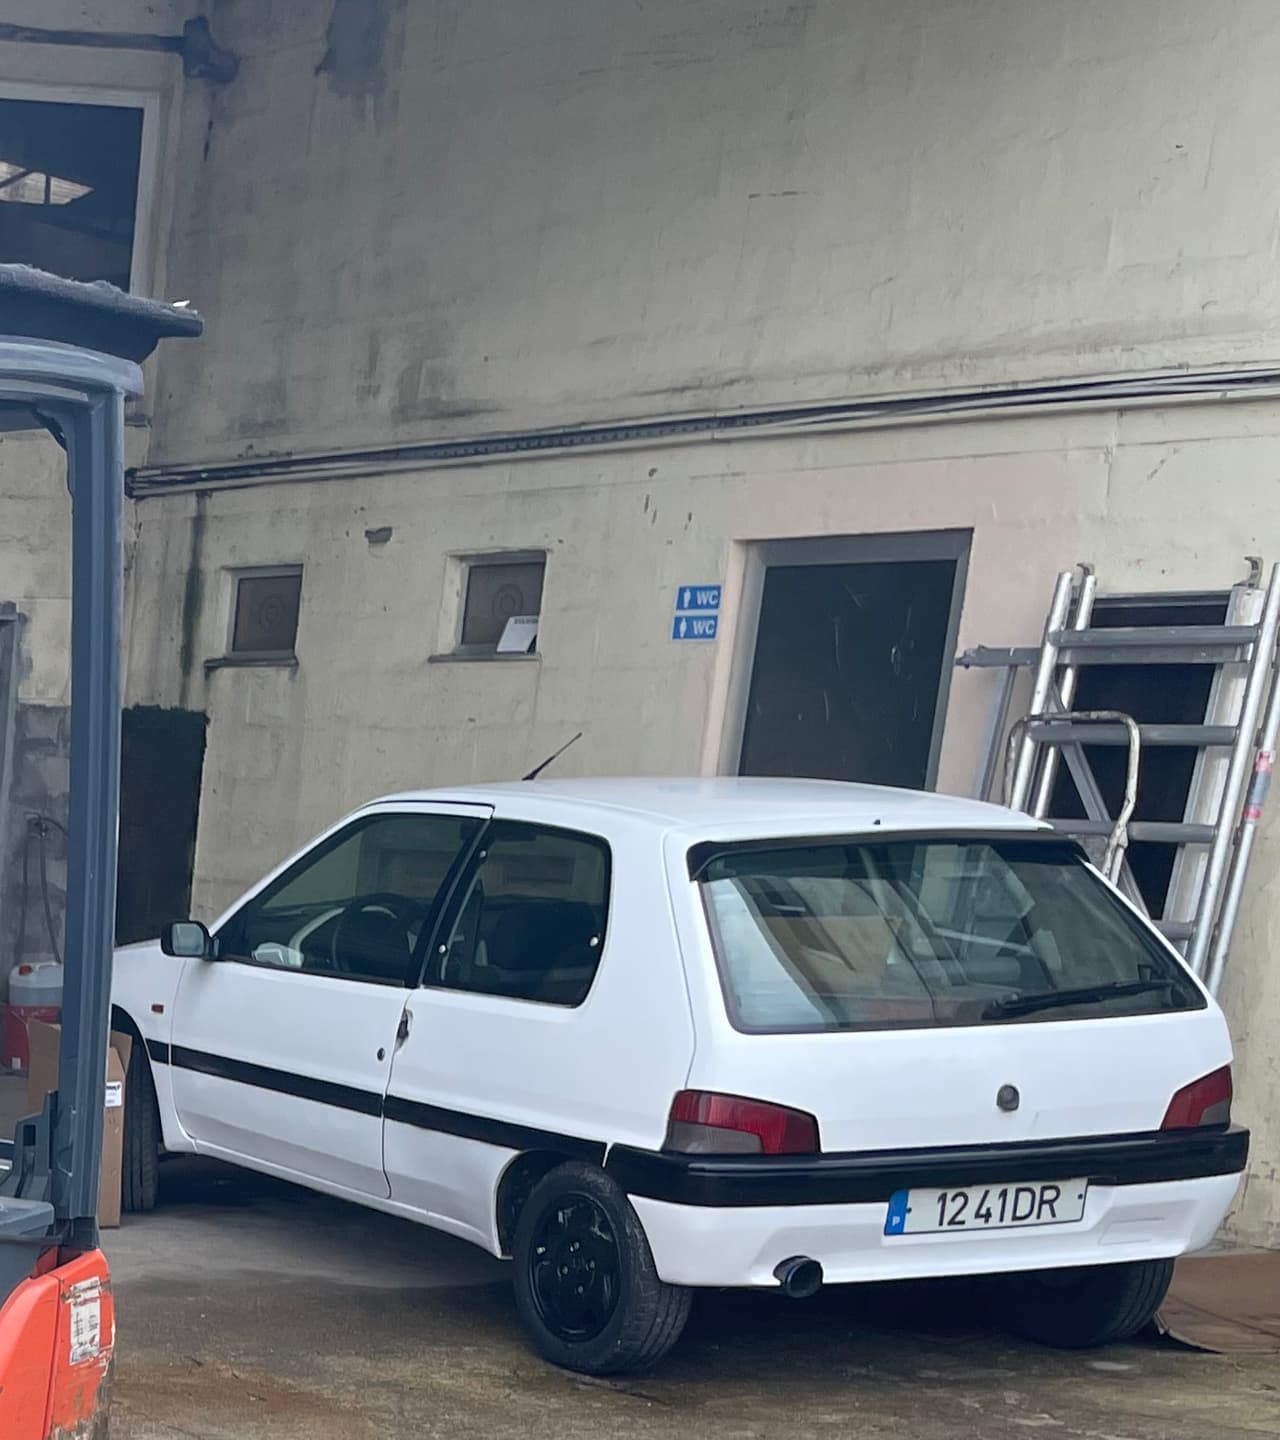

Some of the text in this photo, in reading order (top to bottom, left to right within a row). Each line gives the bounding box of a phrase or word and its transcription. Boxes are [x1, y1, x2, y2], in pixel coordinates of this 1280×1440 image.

[696, 590, 719, 606] WC
[692, 619, 715, 636] WC
[891, 1215, 901, 1227] P
